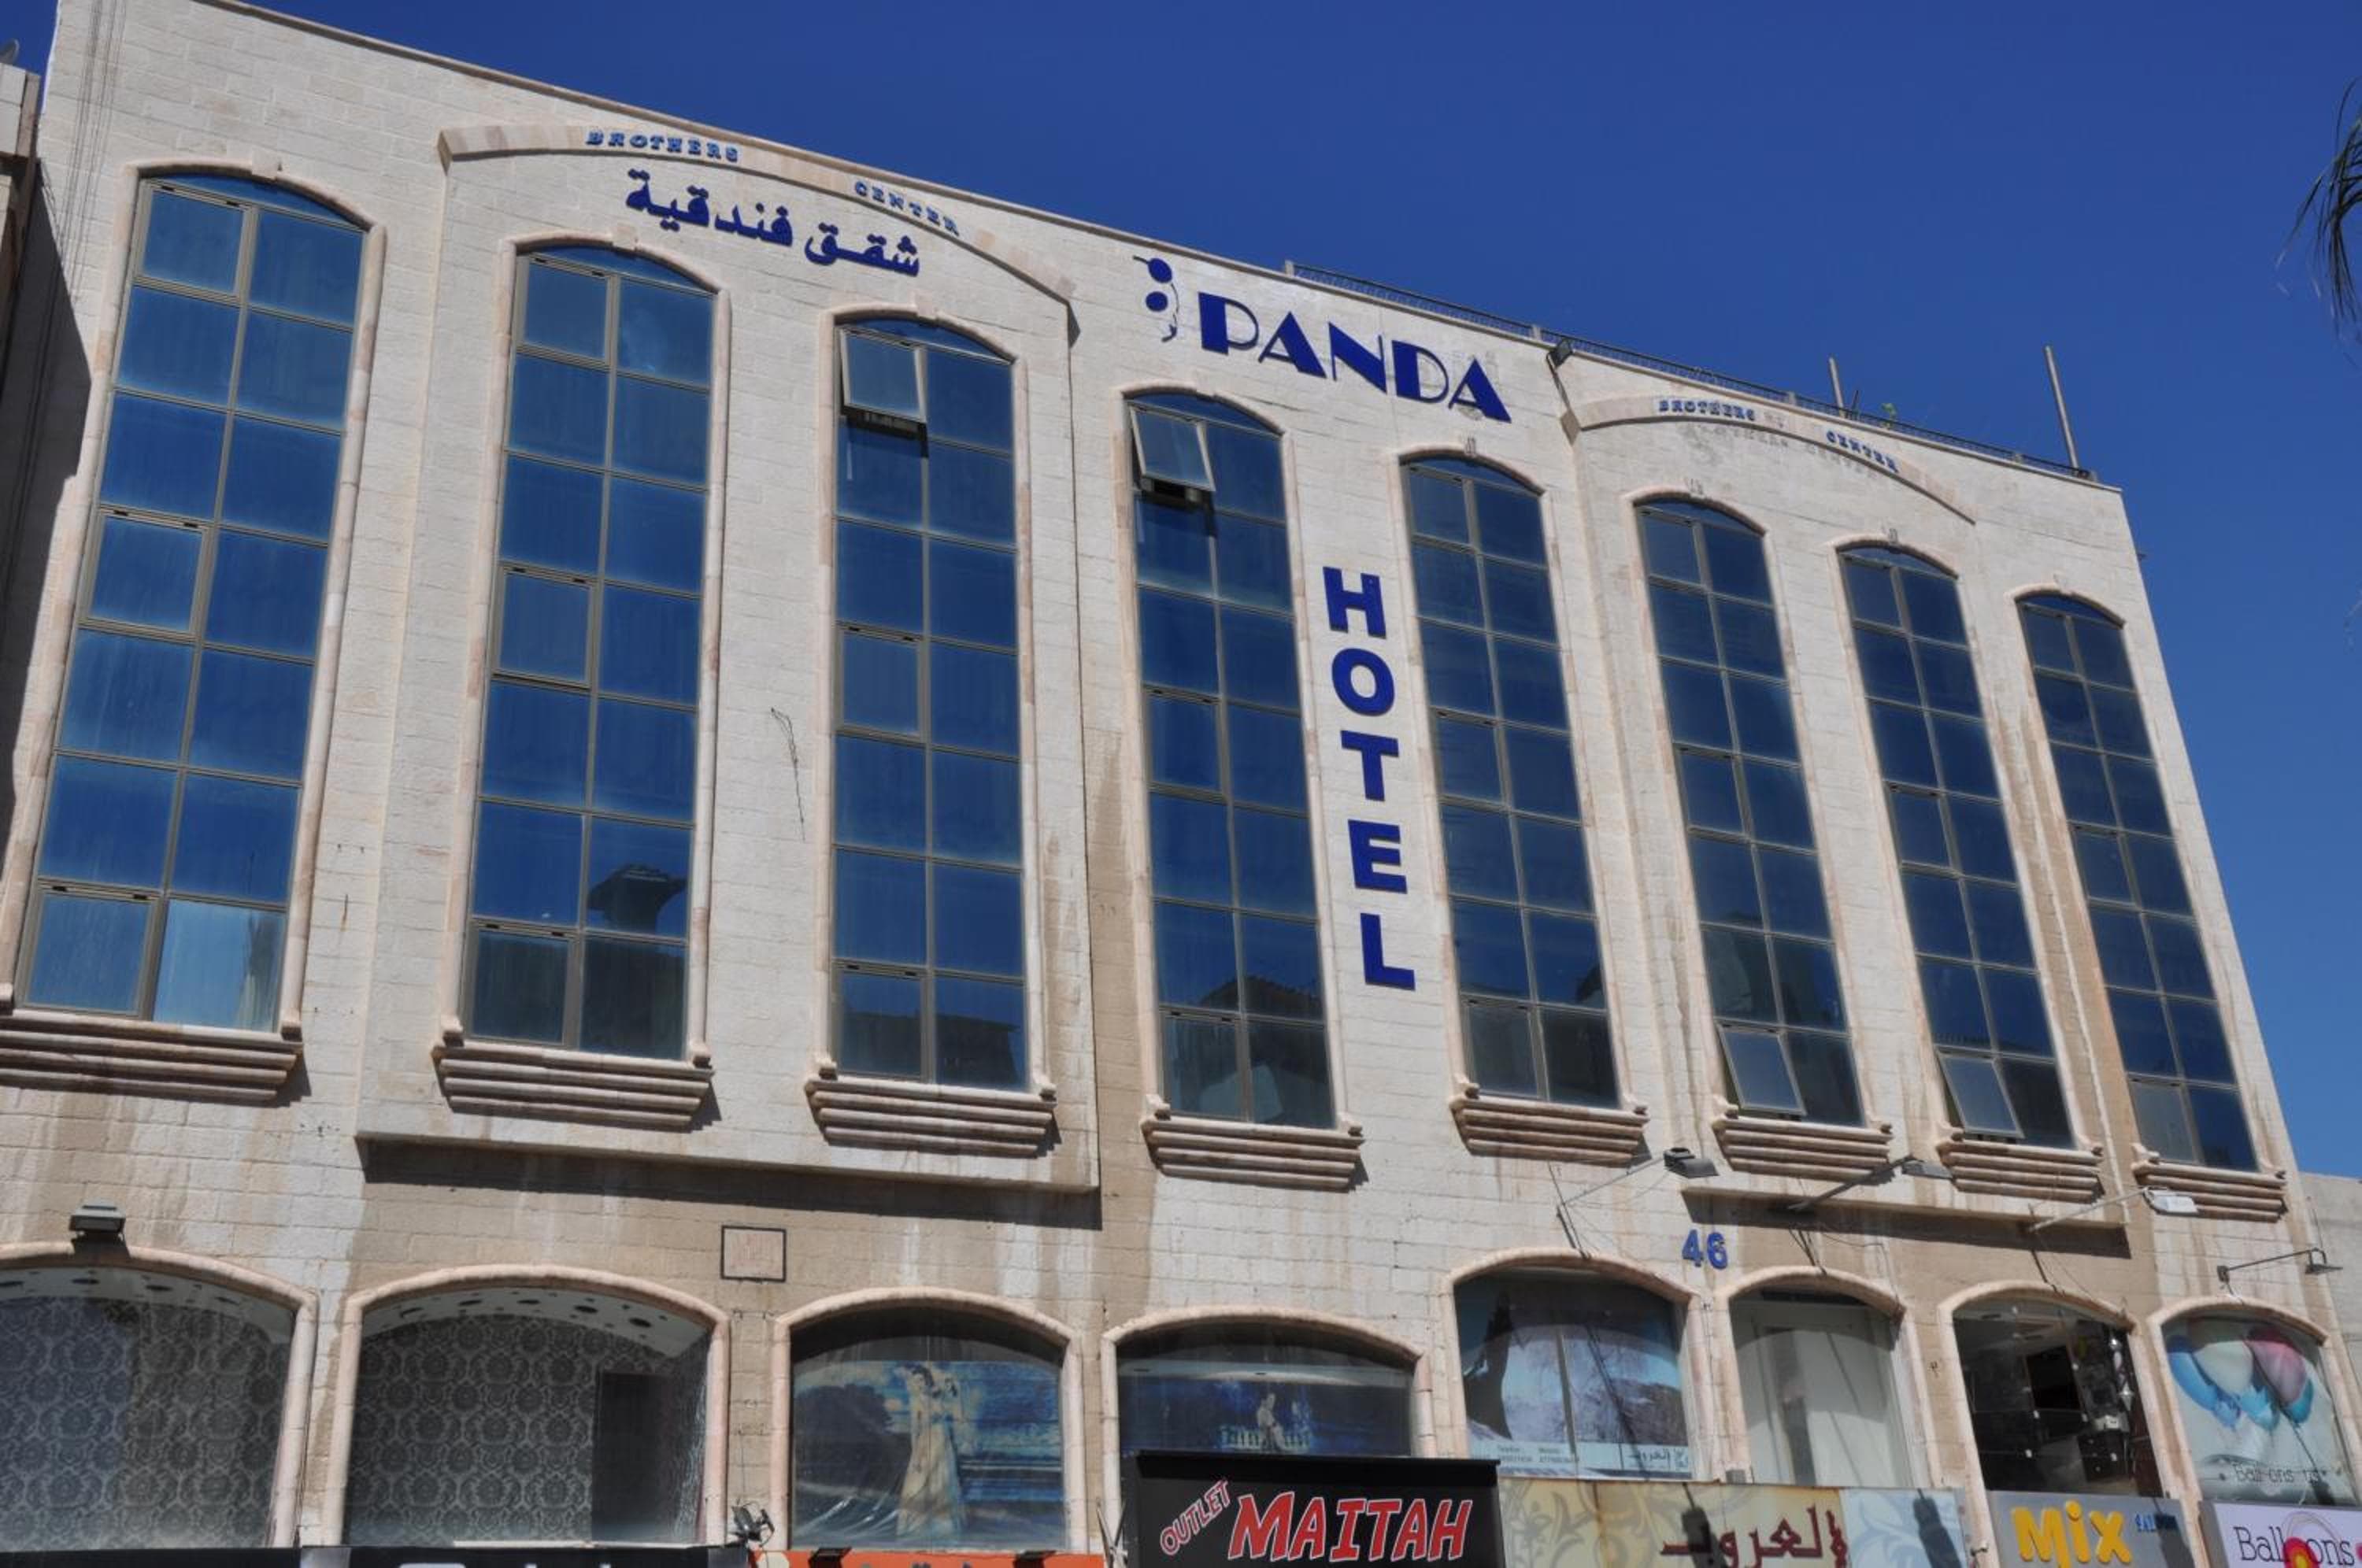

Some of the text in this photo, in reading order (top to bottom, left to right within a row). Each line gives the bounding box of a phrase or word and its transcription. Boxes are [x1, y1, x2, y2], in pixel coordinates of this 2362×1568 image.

[587, 129, 959, 236] BROTHERS CENTER
[628, 170, 920, 276] شقق فندقية
[1199, 292, 1512, 423] PANDA
[1659, 399, 1899, 472] BROTHERS CENTER
[1323, 566, 1416, 991] HOTEL
[1683, 1229, 1728, 1270] 46
[1160, 1478, 1231, 1556] OUTLET
[1227, 1492, 1472, 1562] MAITAH
